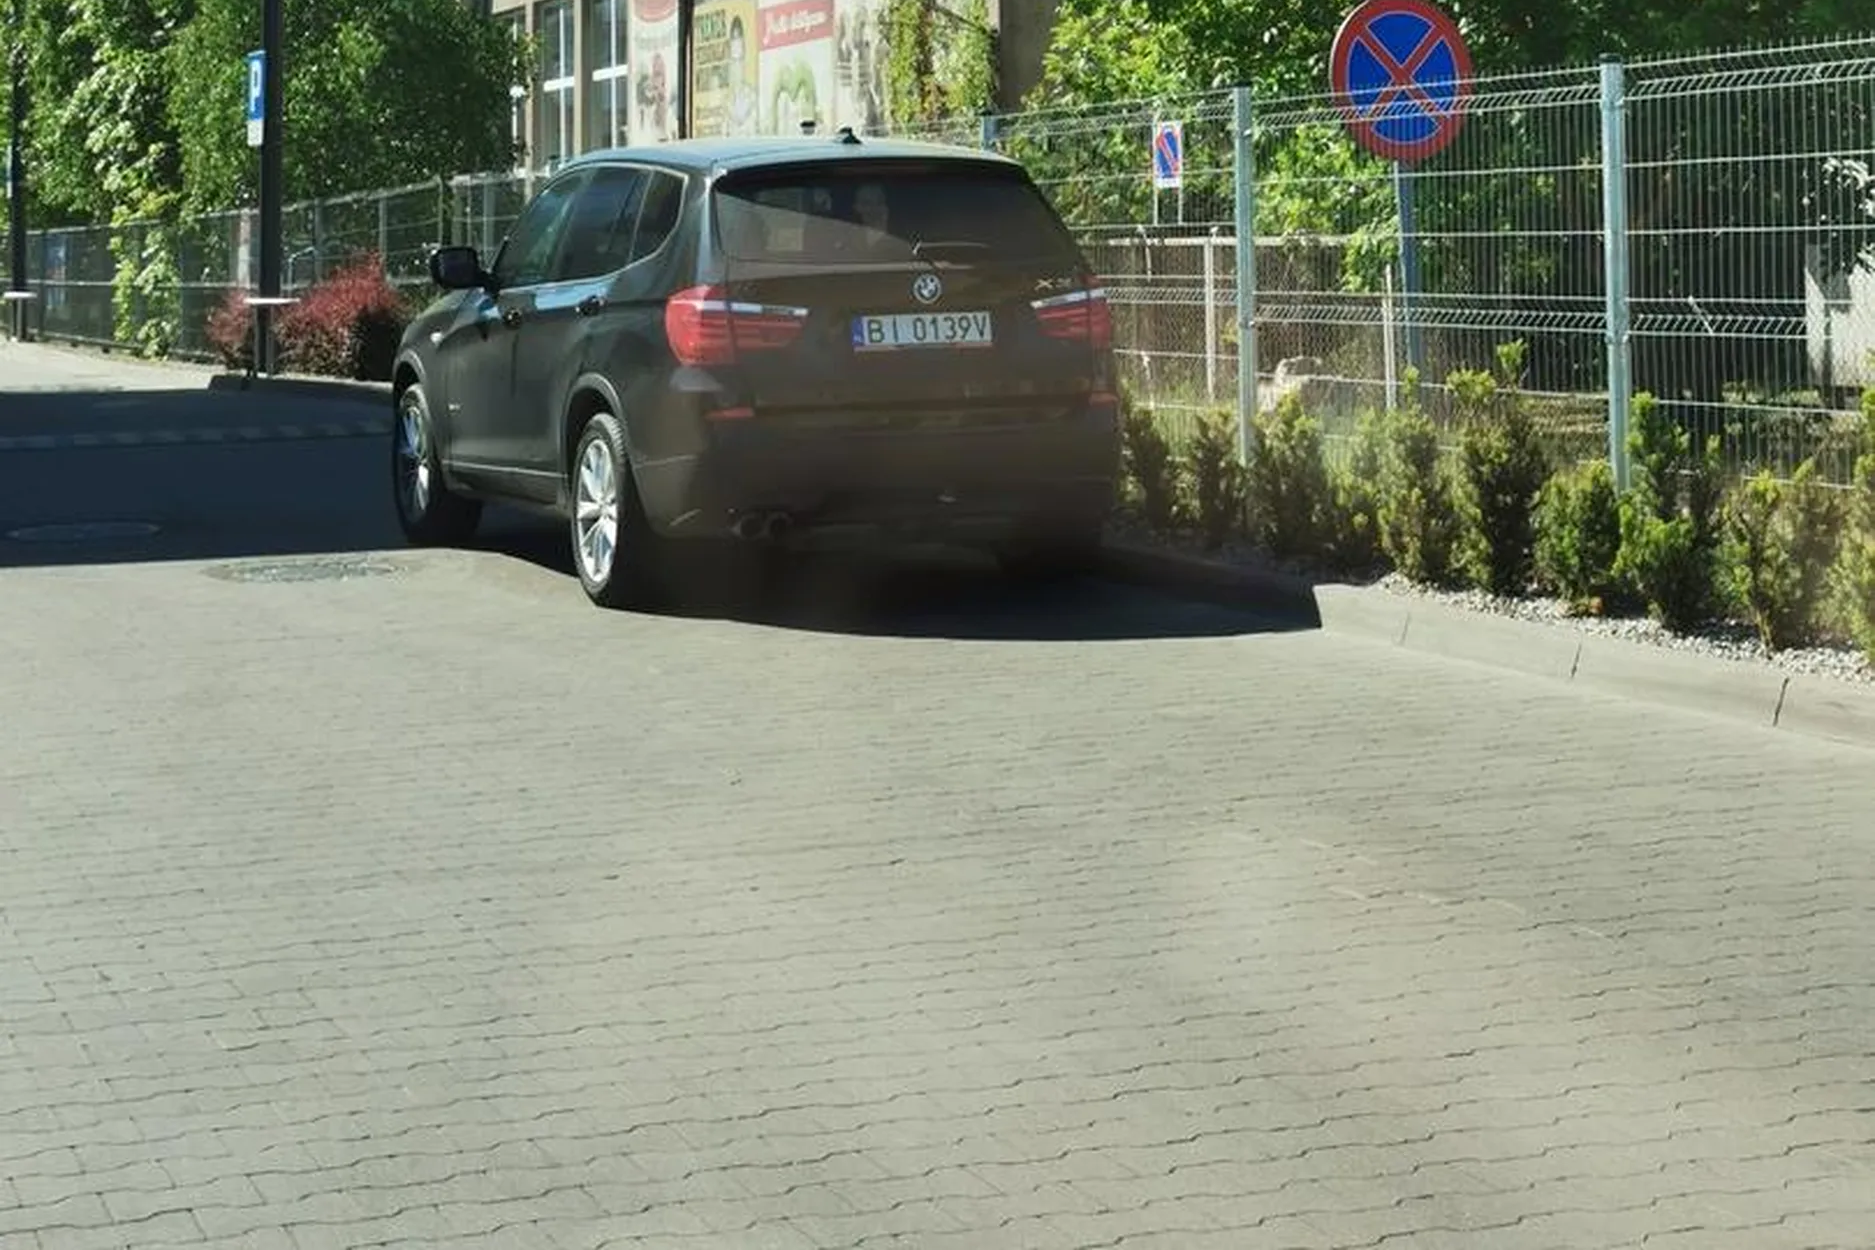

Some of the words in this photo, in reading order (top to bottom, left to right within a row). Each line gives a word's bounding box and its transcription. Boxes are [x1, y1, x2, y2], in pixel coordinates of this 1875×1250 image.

[249, 59, 262, 112] P
[867, 317, 899, 343] BI
[912, 314, 987, 341] 0139V
